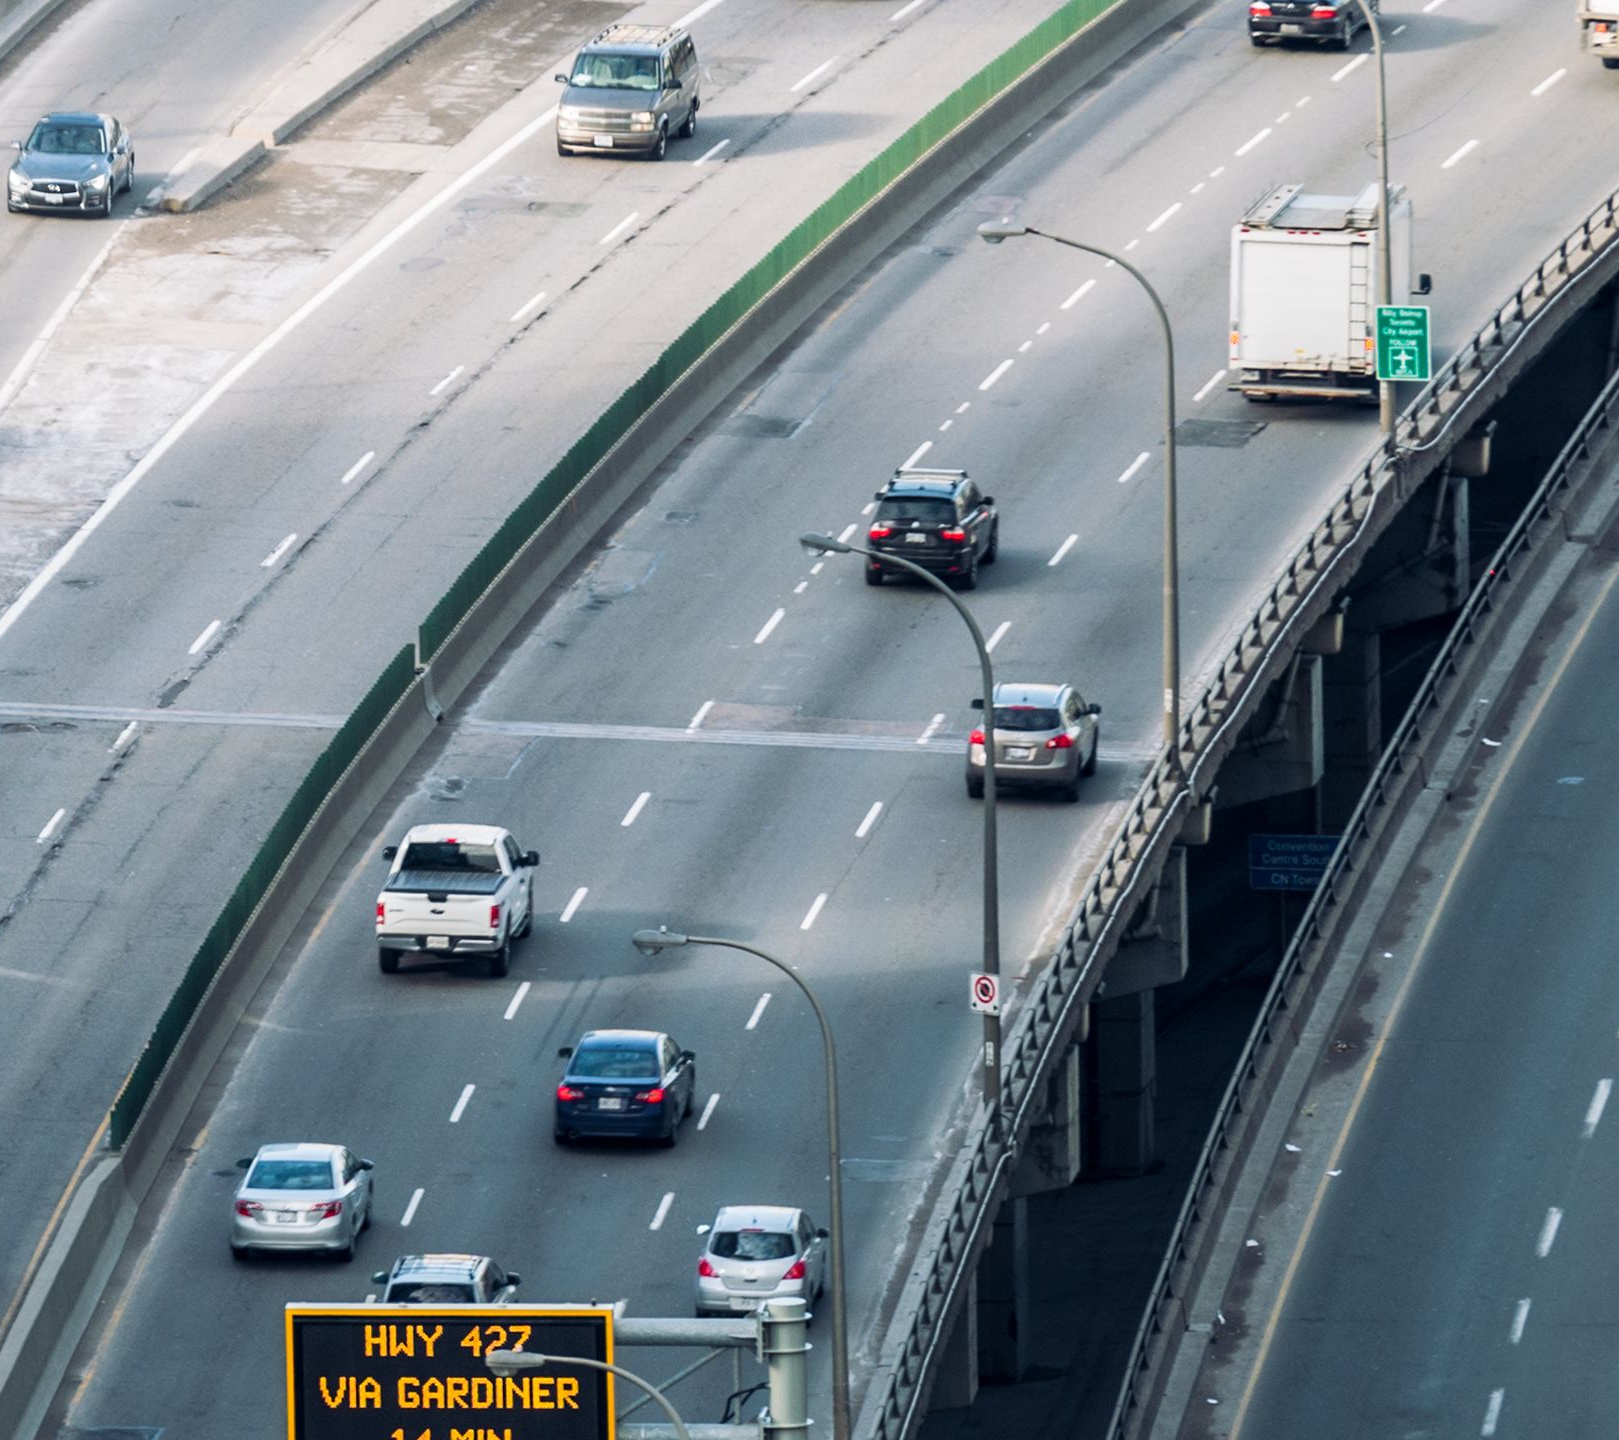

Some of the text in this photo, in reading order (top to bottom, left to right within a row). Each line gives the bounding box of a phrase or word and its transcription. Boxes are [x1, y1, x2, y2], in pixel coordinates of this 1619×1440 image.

[1382, 328, 1423, 336] City Airport
[1267, 840, 1329, 852] Convention
[1271, 872, 1289, 885] CN
[364, 1325, 531, 1357] HWY 427
[320, 1377, 579, 1409] VIA GARDINER
